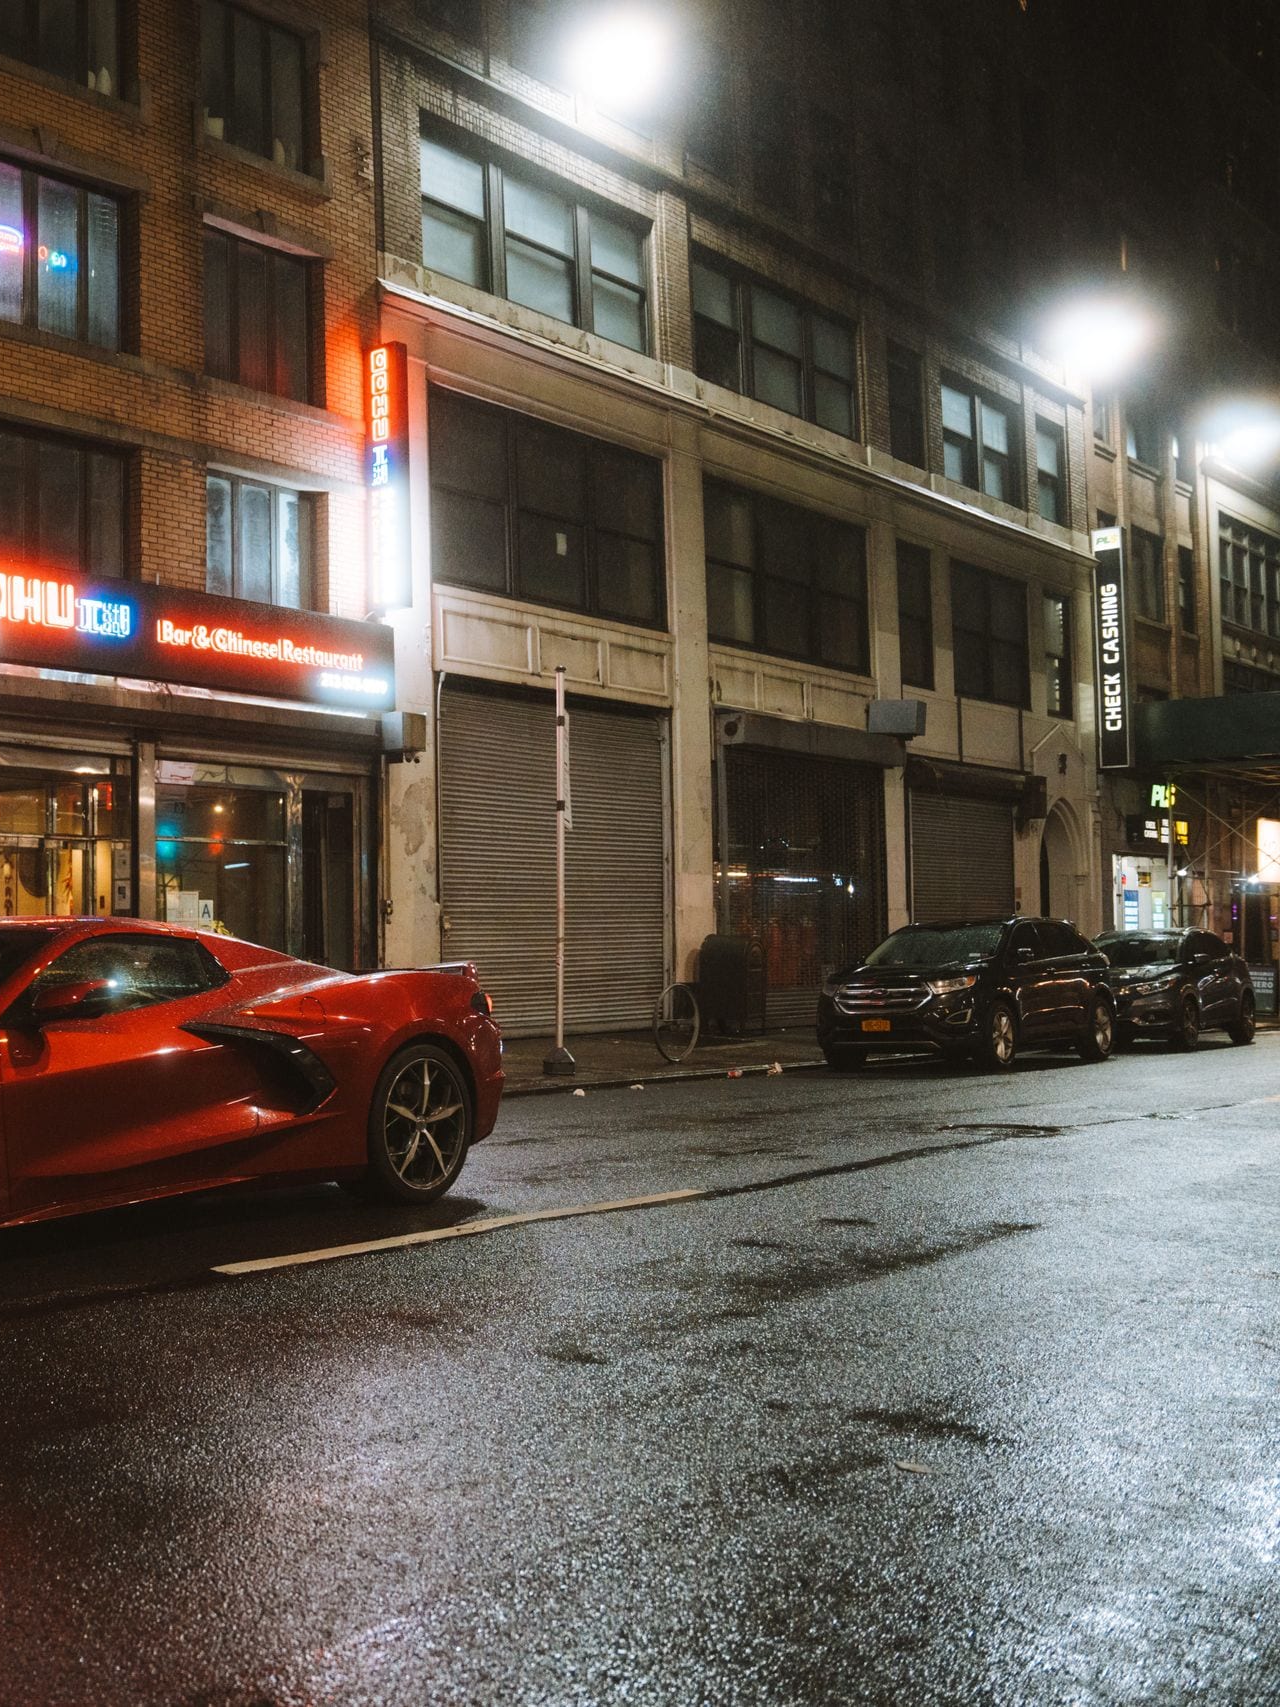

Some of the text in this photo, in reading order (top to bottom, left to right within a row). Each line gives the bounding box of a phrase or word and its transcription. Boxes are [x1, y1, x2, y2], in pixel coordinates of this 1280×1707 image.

[157, 618, 364, 671] Bar & Chinese Restaurant
[1100, 583, 1122, 732] CHECK CASHING
[201, 903, 211, 920] A
